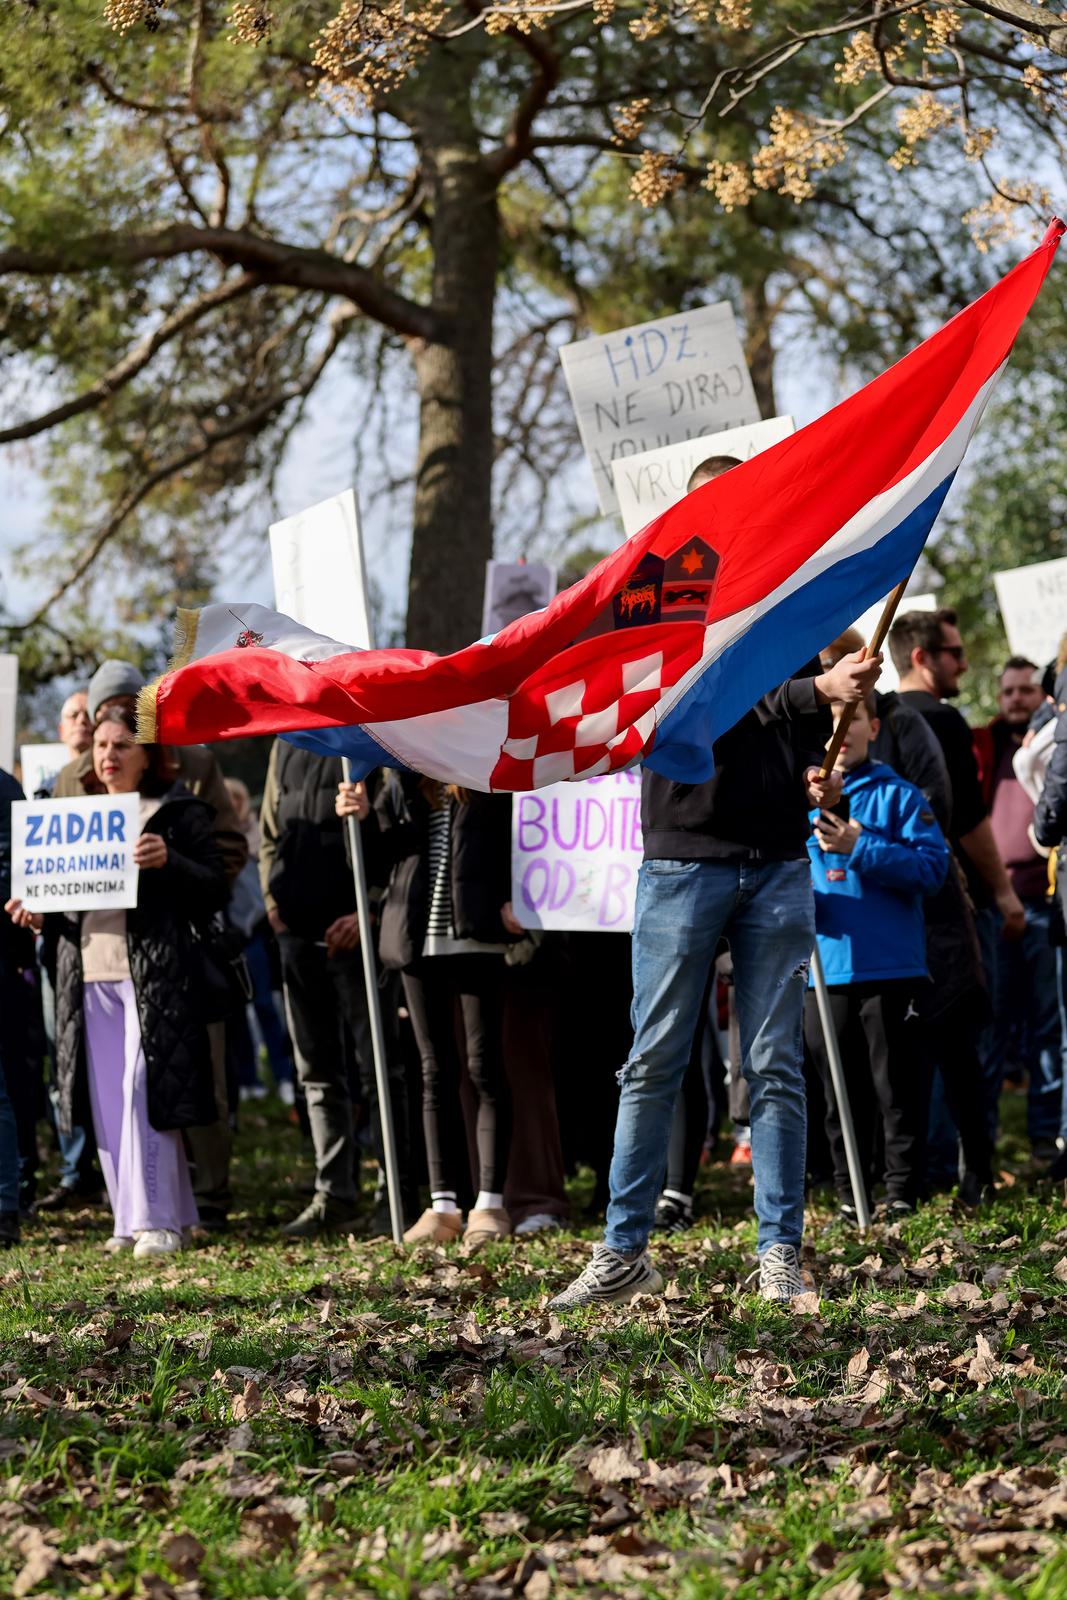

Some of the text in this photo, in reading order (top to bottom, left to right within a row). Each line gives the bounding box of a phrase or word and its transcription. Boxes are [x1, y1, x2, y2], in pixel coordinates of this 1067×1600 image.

[594, 364, 745, 432] NE DIRAJ
[25, 810, 126, 847] ZADAR
[24, 853, 125, 875] ZADRANIMA!
[26, 880, 125, 897] NE POJEDINCIMA
[522, 857, 576, 912] OD
